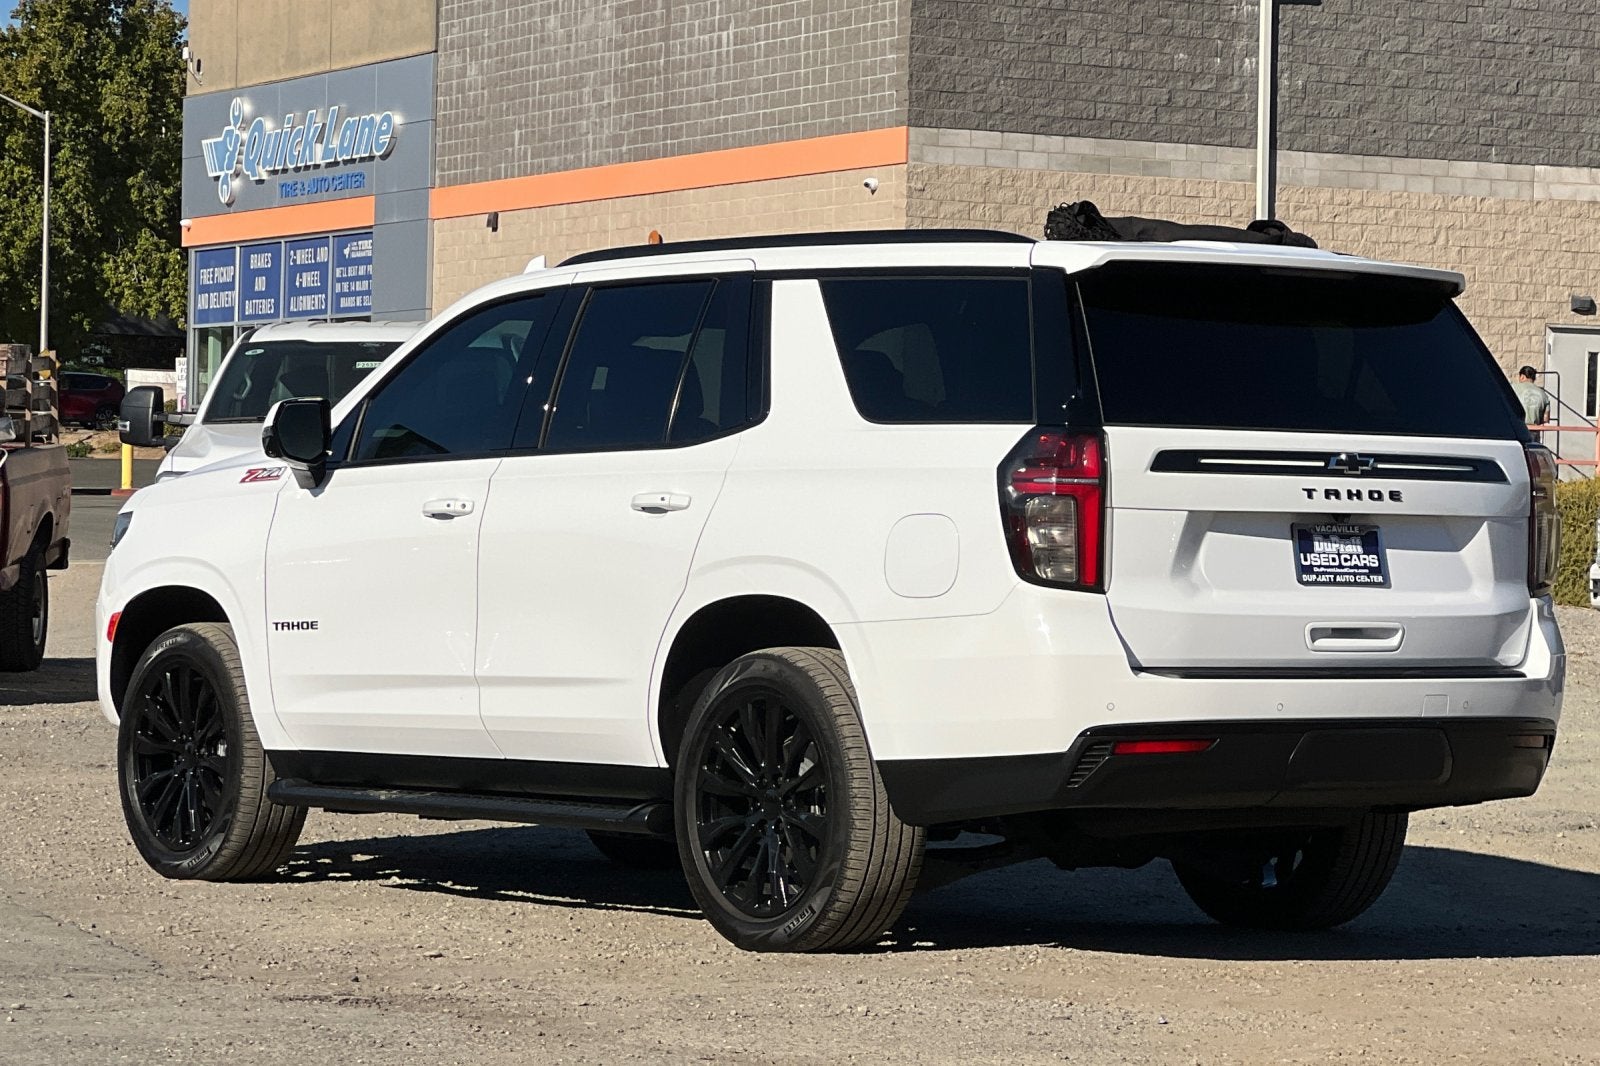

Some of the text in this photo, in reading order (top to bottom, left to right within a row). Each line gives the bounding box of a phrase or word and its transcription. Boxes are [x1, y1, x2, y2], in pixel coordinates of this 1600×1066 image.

[243, 106, 394, 181] Quick Lane
[279, 181, 300, 199] TIRE
[306, 176, 330, 195] AUTO
[330, 171, 365, 192] CENTER
[250, 252, 272, 270] BRAKES
[290, 246, 328, 266] 2-WHEEL AND
[200, 265, 235, 286] FREE PICKUP
[295, 270, 321, 288] 4-WHEEL
[348, 265, 358, 277] BEAT
[358, 264, 367, 276] ANY
[254, 276, 266, 292] AND
[350, 281, 355, 292] 14
[356, 280, 369, 291] MAJOR
[197, 290, 236, 310] AND DELIVERY
[245, 298, 275, 316] BATTERIES
[289, 293, 326, 312] ALIGNMENTS
[340, 296, 356, 308] BRANDS
[356, 296, 362, 307] WE
[1302, 488, 1404, 502] TAHOE
[1315, 525, 1359, 533] VACAVILLE
[1300, 553, 1379, 567] USED CARS
[272, 620, 319, 631] TAHOE
[784, 904, 817, 937] PIRELLI
